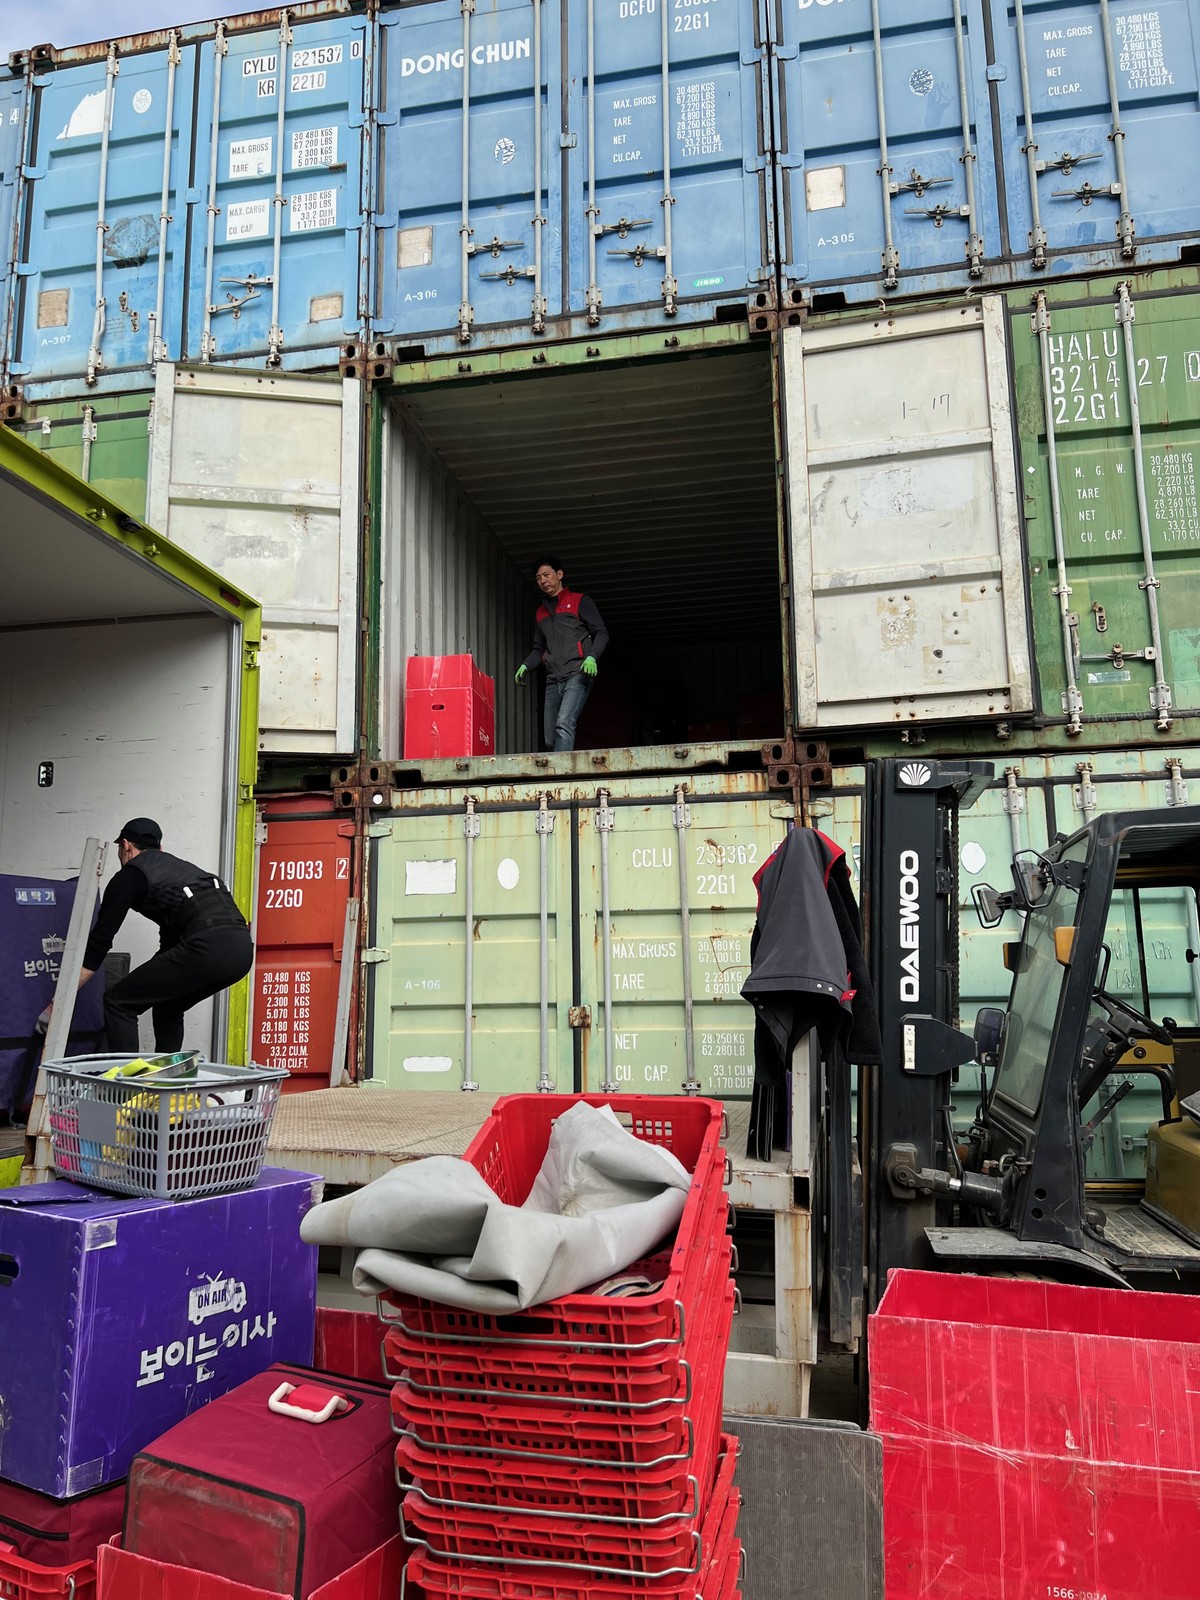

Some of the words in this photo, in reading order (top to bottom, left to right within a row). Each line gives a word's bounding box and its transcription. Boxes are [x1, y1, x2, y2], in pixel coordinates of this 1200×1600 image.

[620, 0, 655, 18] DCFU
[674, 12, 710, 32] 22G1
[1143, 12, 1159, 22] KGS
[1144, 21, 1160, 31] LBS
[1043, 31, 1066, 41] MAX.
[1067, 26, 1093, 38] GROSS
[1145, 30, 1162, 40] KGS
[1146, 39, 1162, 49] LBS
[401, 49, 464, 77] DONG
[471, 38, 530, 65] CHUN
[1045, 48, 1067, 59] TARE
[1147, 49, 1163, 59] KGS
[244, 57, 276, 75] CYLU
[1148, 58, 1164, 68] LBS
[1046, 66, 1062, 77] NET
[258, 80, 275, 96] KR
[292, 73, 325, 91] 2210
[701, 82, 715, 92] KGS
[701, 91, 715, 101] LBS
[613, 99, 632, 110] MAX.
[634, 95, 656, 107] GROSS
[701, 100, 715, 110] KGS
[702, 109, 715, 118] LBS
[613, 116, 632, 127] TARE
[702, 118, 716, 128] KGS
[321, 128, 333, 137] KGS
[702, 127, 716, 136] LBS
[321, 137, 333, 146] LBS
[613, 134, 626, 145] NET
[248, 143, 268, 153] GROSS
[321, 146, 333, 155] KGS
[233, 164, 248, 173] TARE
[320, 191, 332, 200] KGS
[246, 204, 266, 214] CARGO
[319, 199, 332, 208] LBS
[1048, 330, 1118, 364] HALU
[1051, 360, 1120, 394] 3214
[1054, 392, 1119, 424] 22G1
[1150, 454, 1179, 466] 30.480
[1181, 453, 1193, 463] KG
[1151, 464, 1180, 476] 67.200
[1182, 463, 1193, 474] LB
[1157, 476, 1181, 487] 2.220
[1184, 475, 1194, 486] KG
[1077, 488, 1100, 499] TARE
[1158, 487, 1182, 497] 4.890
[1184, 485, 1195, 496] LB
[1186, 497, 1196, 508] KG
[1078, 510, 1096, 521] NET
[1187, 507, 1197, 518] LB
[1167, 519, 1185, 530] 33.2
[632, 848, 672, 868] CCLU
[269, 860, 323, 880] 719033
[338, 859, 346, 878] 2
[696, 874, 735, 894] 22G1
[900, 850, 920, 1002] DAEWOO
[729, 940, 740, 951] KG
[730, 952, 741, 962] LB
[263, 972, 289, 983] 30.480
[295, 971, 311, 982] KGS
[614, 974, 645, 990] TARE
[731, 971, 742, 982] KG
[262, 984, 288, 995] 67.200
[294, 983, 311, 994] LBS
[267, 996, 288, 1008] 2.300
[294, 996, 310, 1006] KGS
[266, 1008, 288, 1019] 5.070
[294, 1008, 310, 1019] LBS
[261, 1021, 288, 1032] 28.180
[293, 1020, 310, 1031] KGS
[261, 1033, 287, 1044] 62.130
[293, 1033, 309, 1043] LBS
[615, 1033, 638, 1050] NET
[733, 1033, 745, 1044] KG
[270, 1046, 287, 1057] 33.2
[734, 1045, 745, 1056] LB
[615, 1065, 634, 1081] CU.
[644, 1065, 670, 1081] CAP.
[713, 1065, 732, 1076] 33.1
[708, 1078, 732, 1088] 1.170
[734, 1078, 753, 1088] CU.F
[198, 1293, 210, 1308] ON
[212, 1288, 226, 1305] AIR
[136, 1332, 218, 1388] 보이는
[223, 1311, 277, 1348] 이사
